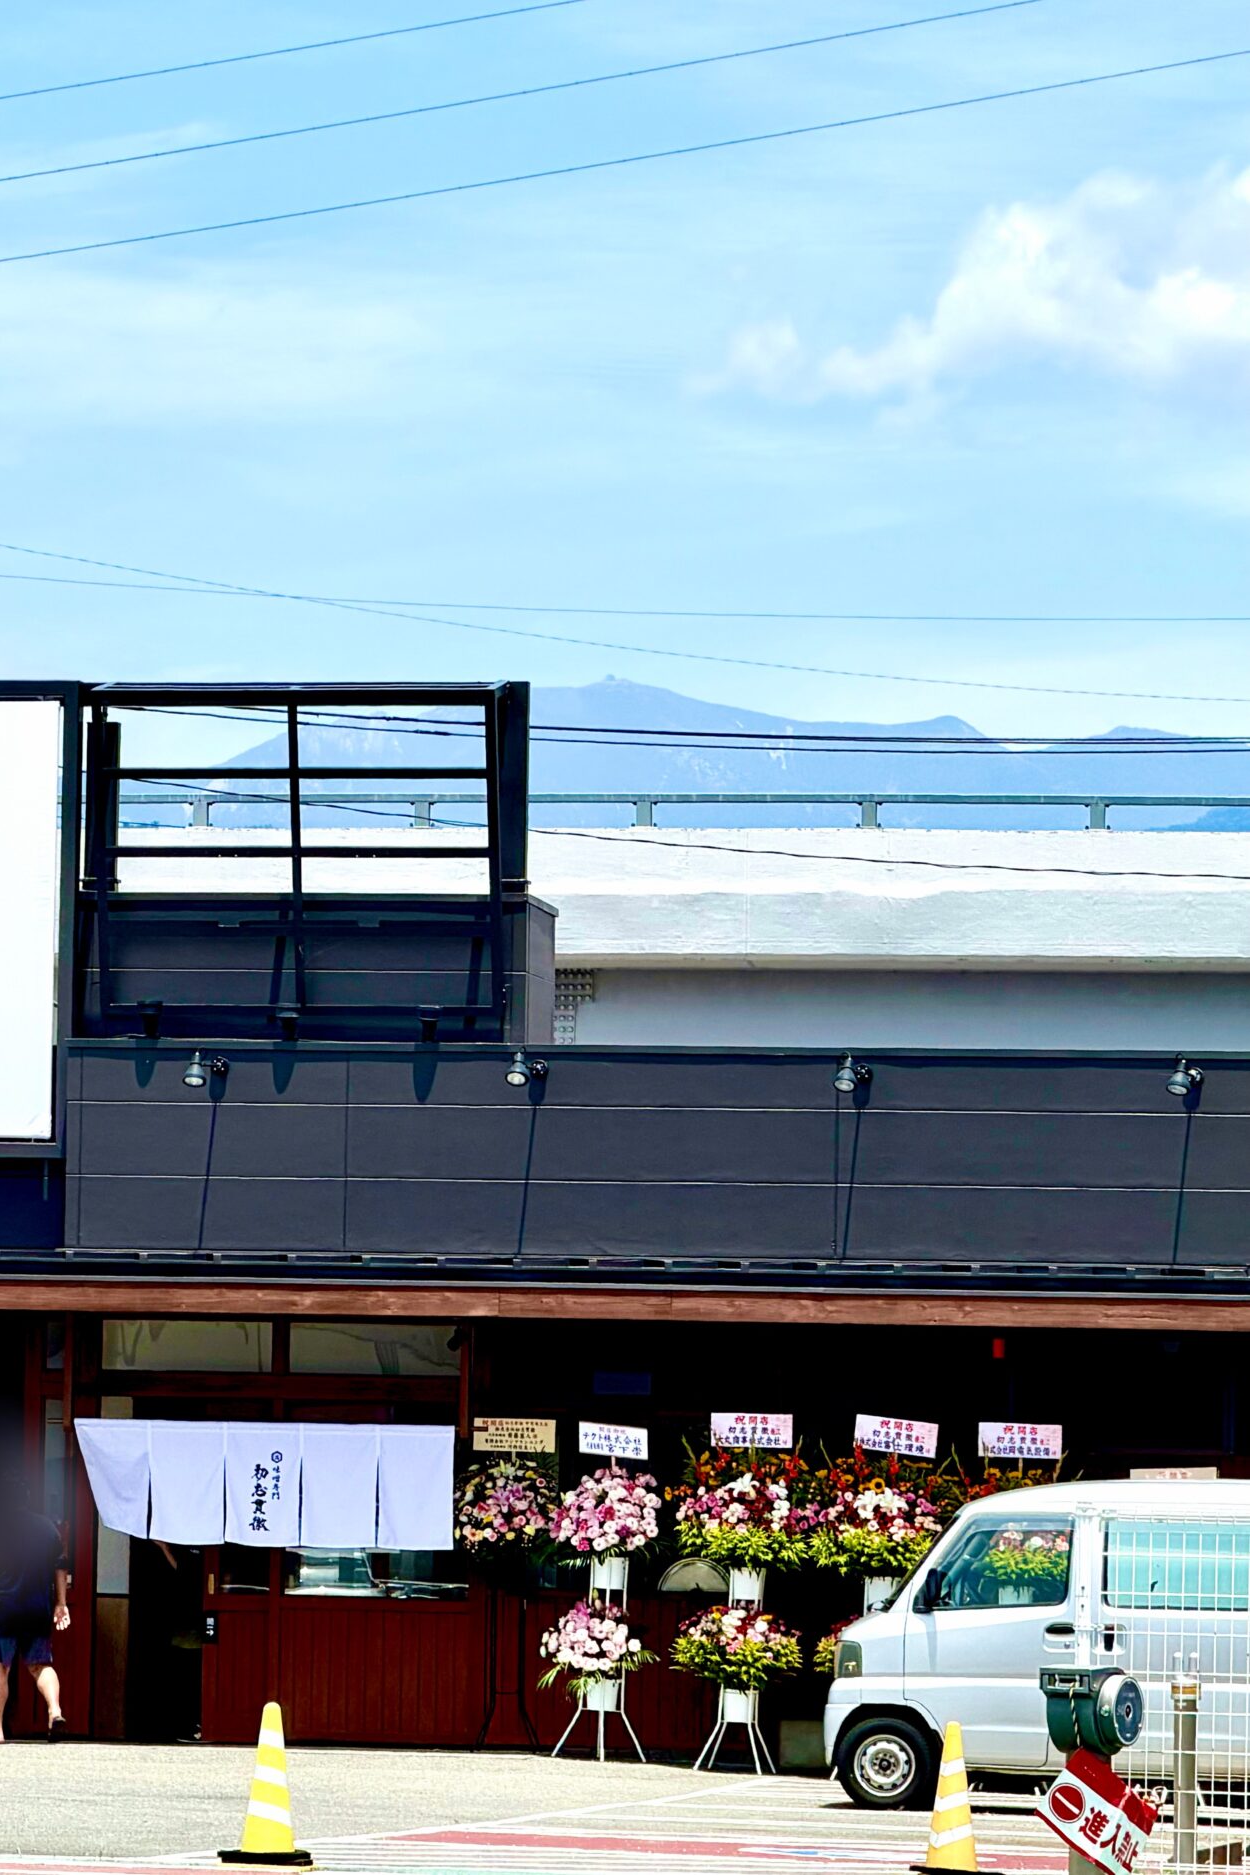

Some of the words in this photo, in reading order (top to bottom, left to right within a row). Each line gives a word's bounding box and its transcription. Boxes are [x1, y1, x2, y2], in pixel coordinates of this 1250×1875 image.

[734, 1415, 770, 1426] 祝開店
[879, 1419, 914, 1433] 祝開店
[1002, 1425, 1038, 1436] 祝開店
[249, 1463, 270, 1532] 初志貫徹
